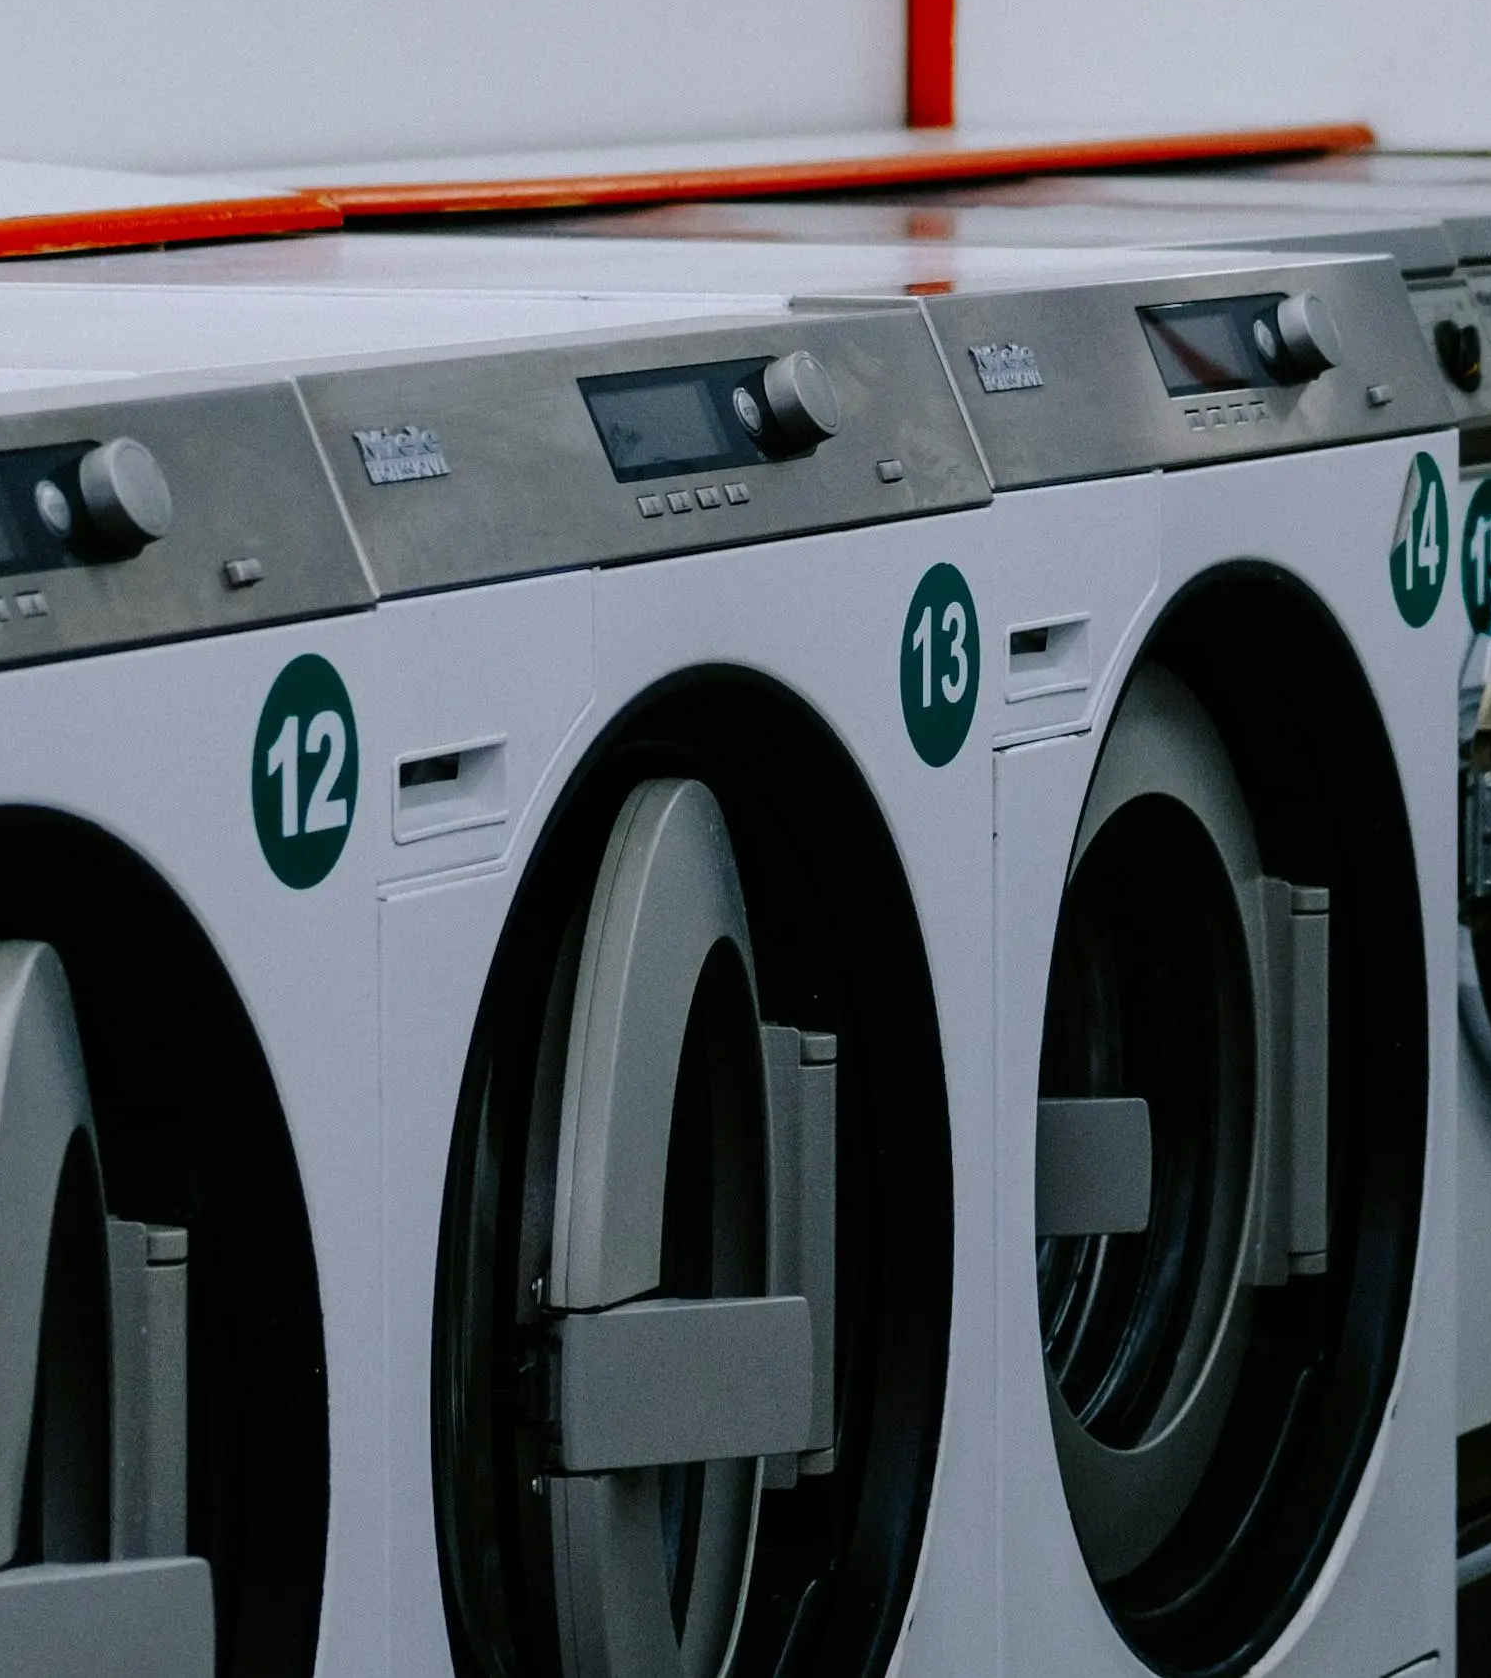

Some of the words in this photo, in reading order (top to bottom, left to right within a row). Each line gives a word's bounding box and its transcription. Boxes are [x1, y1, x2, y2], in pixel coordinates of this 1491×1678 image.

[1405, 481, 1440, 591] 14
[912, 601, 969, 708] 13
[266, 709, 348, 838] 12
